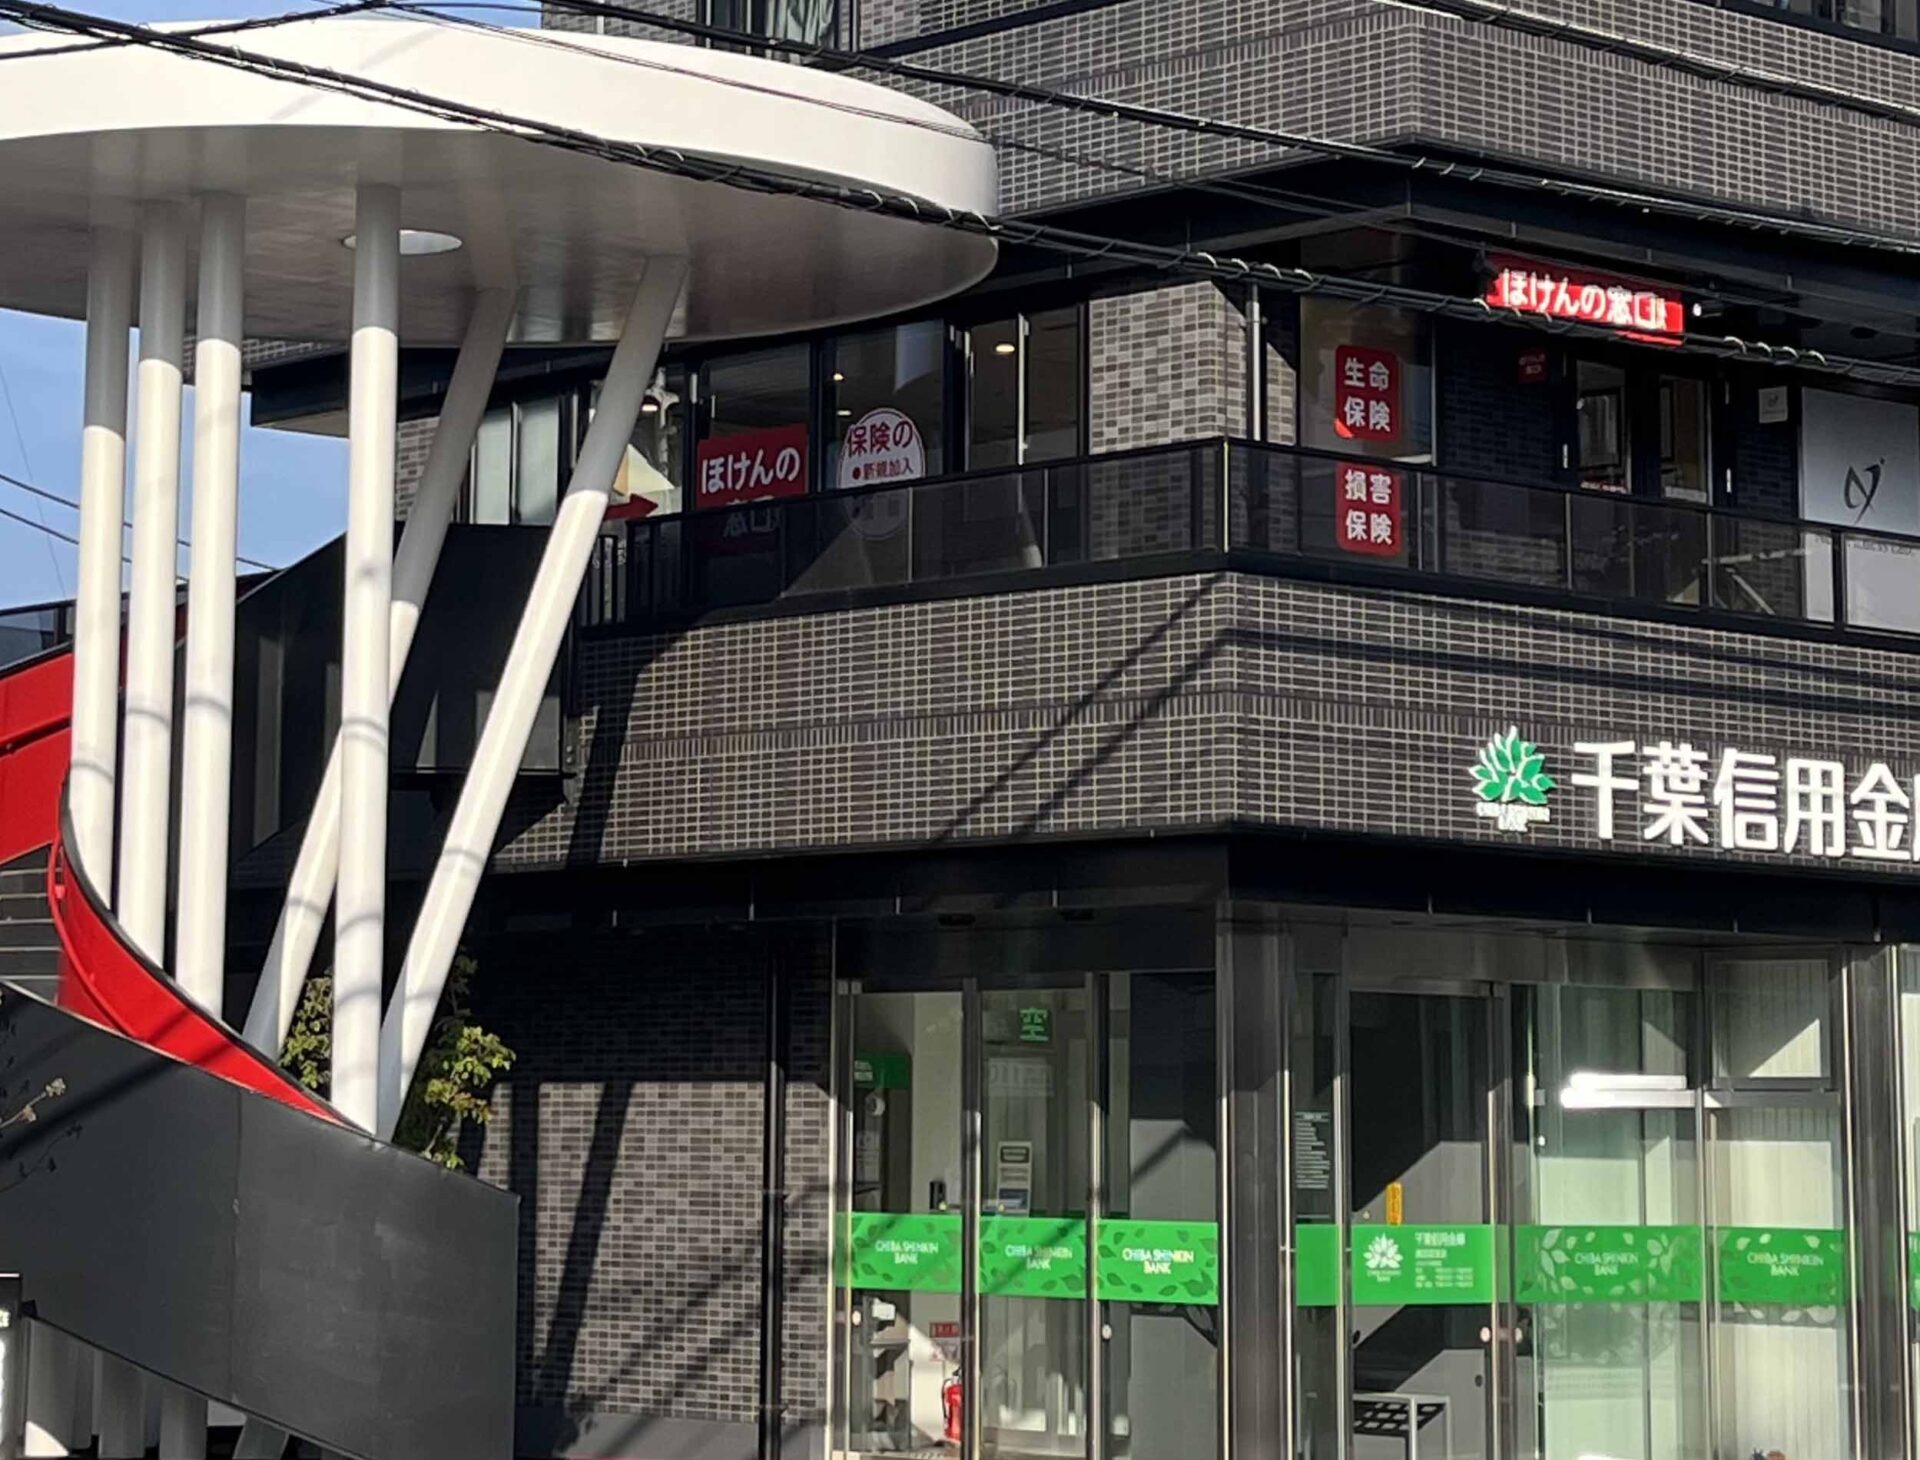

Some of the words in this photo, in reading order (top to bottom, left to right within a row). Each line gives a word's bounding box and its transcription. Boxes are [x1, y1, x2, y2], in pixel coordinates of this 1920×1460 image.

[1501, 267, 1667, 330] ほけんの窓口
[1344, 357, 1390, 391] 生命
[1344, 396, 1391, 432] 保険
[848, 420, 913, 458] 保険の
[702, 446, 801, 495] ほけんの
[1345, 469, 1392, 505] 損害
[1346, 509, 1393, 545] 保険
[1571, 740, 1920, 862] 千葉信用金
[1144, 1261, 1171, 1274] BANK
